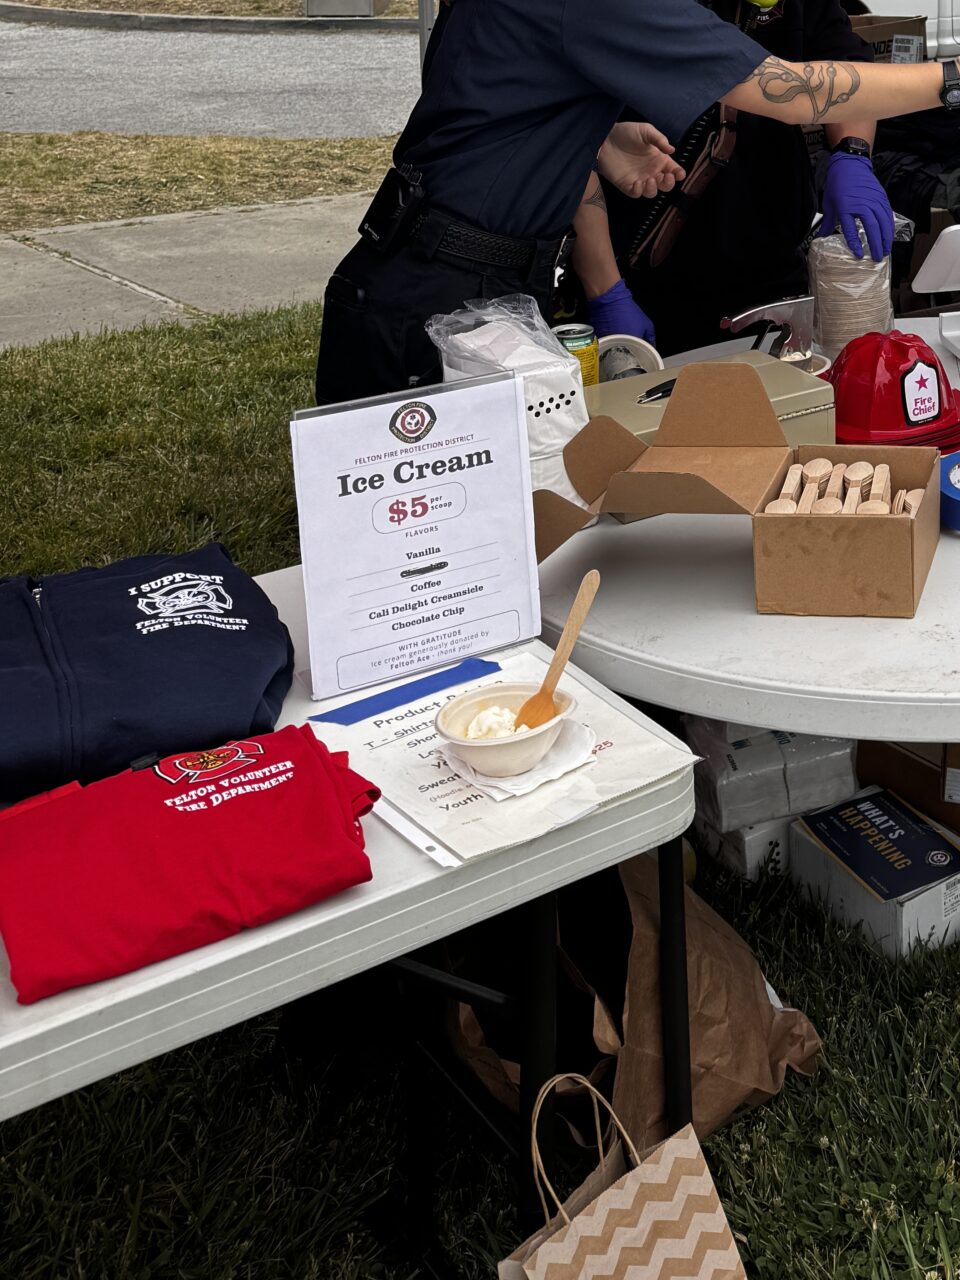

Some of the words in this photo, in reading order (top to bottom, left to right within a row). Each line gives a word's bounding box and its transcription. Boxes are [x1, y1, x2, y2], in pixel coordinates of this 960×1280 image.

[912, 402, 935, 417] Chief
[914, 396, 932, 408] Fire
[355, 454, 383, 465] FELTON
[384, 451, 398, 460] FIRE
[400, 441, 443, 456] PROTECTION
[445, 434, 475, 446] DISTRICT
[337, 473, 385, 497] Ice
[393, 449, 493, 484] Cream
[388, 495, 429, 525] $5
[430, 495, 443, 504] per
[431, 501, 452, 511] scoop
[405, 525, 439, 538] FLAVORS
[406, 546, 441, 560] Vanilla
[128, 587, 138, 596] I
[140, 572, 224, 593] SUPPORT
[410, 579, 442, 592] Coffee
[368, 608, 389, 620] Cali
[392, 599, 428, 615] Delight
[430, 585, 484, 604] Creamsicle
[135, 617, 181, 630] FELTON
[185, 613, 249, 625] VOLUNTEER
[141, 622, 170, 635] FIRE
[174, 619, 247, 631] DEPARTMENT
[391, 613, 440, 631] Chocolate
[442, 606, 465, 618] Chip
[398, 641, 419, 652] WITH
[421, 629, 462, 646] GRATITUDE
[384, 654, 407, 664] cream
[408, 641, 448, 659] generously
[390, 659, 415, 670] Felton
[373, 701, 441, 728] Product
[406, 732, 439, 749] Shor
[164, 784, 216, 807] FELTON
[219, 760, 295, 787] VOLUNTEER
[175, 801, 208, 812] FIRE
[210, 771, 294, 807] DEPARTMENT
[418, 772, 462, 793] Sweat
[438, 793, 484, 812] Youth
[857, 801, 905, 839] WHAT'S
[838, 807, 912, 871] HAPPENING
